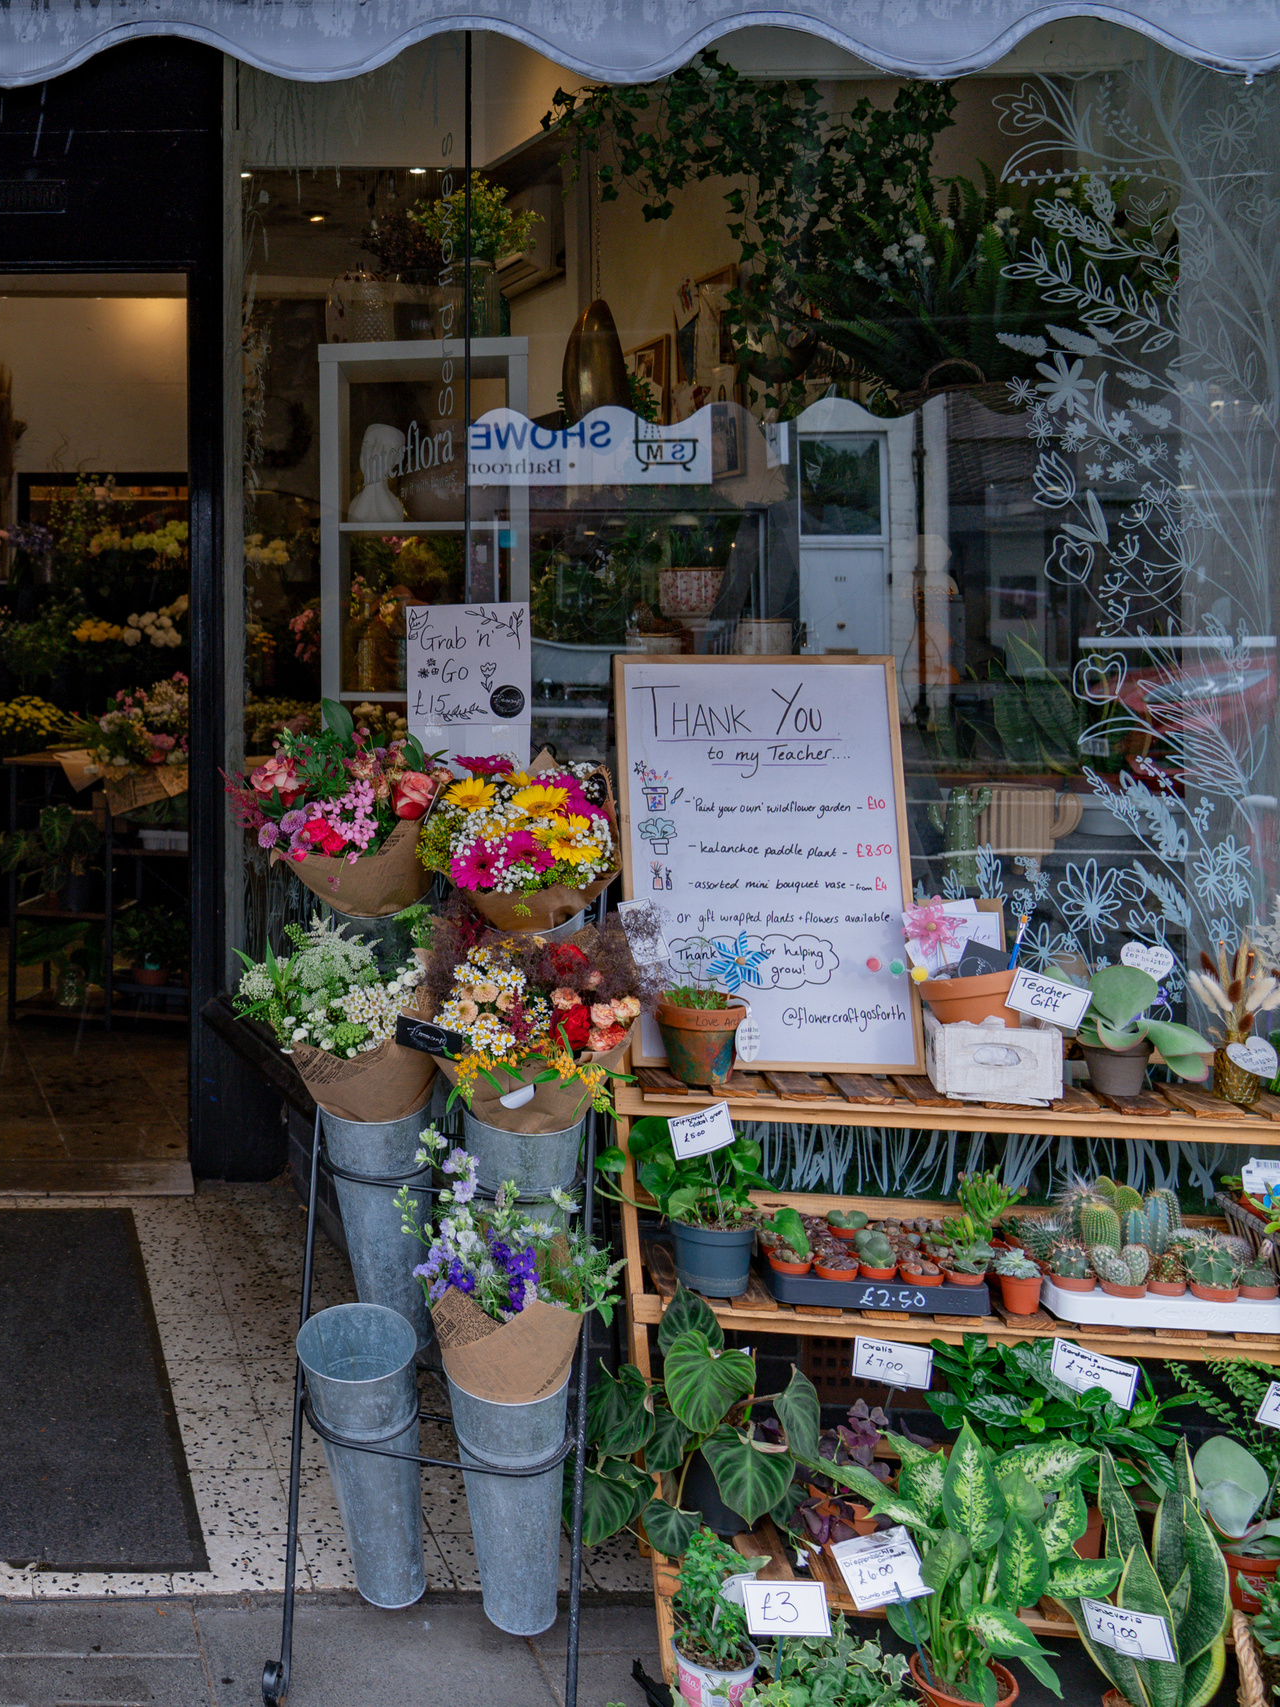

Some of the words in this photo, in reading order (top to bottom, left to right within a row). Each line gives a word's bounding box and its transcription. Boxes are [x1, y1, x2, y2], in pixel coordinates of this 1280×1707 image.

[421, 625, 466, 651] Grab
[441, 658, 468, 683] Go
[707, 747, 724, 760] to
[736, 750, 759, 778] my
[718, 803, 737, 818] your
[766, 801, 816, 815] wildflower
[819, 803, 851, 819] garden
[867, 796, 886, 810] £10
[700, 841, 760, 855] kalanchoe
[764, 842, 803, 858] paddle
[807, 842, 837, 859] plant
[745, 880, 770, 890] mini
[776, 879, 820, 894] bouquet
[825, 881, 846, 890] vase
[875, 877, 888, 891] £4
[698, 910, 716, 932] gift
[720, 912, 762, 929] wrapped
[766, 911, 795, 929] plants
[675, 947, 717, 961] Thank
[783, 944, 824, 970] helping
[771, 964, 806, 984] grow!
[1021, 977, 1072, 999] Teacher
[1030, 994, 1060, 1012] Gift
[696, 1016, 719, 1027] Love
[860, 1287, 925, 1308] £2.50
[862, 1343, 893, 1354] Oxalis
[866, 1354, 903, 1371] £7.00
[1065, 1359, 1100, 1380] £7.00
[859, 1564, 893, 1585] £6.00
[761, 1591, 799, 1622] £3
